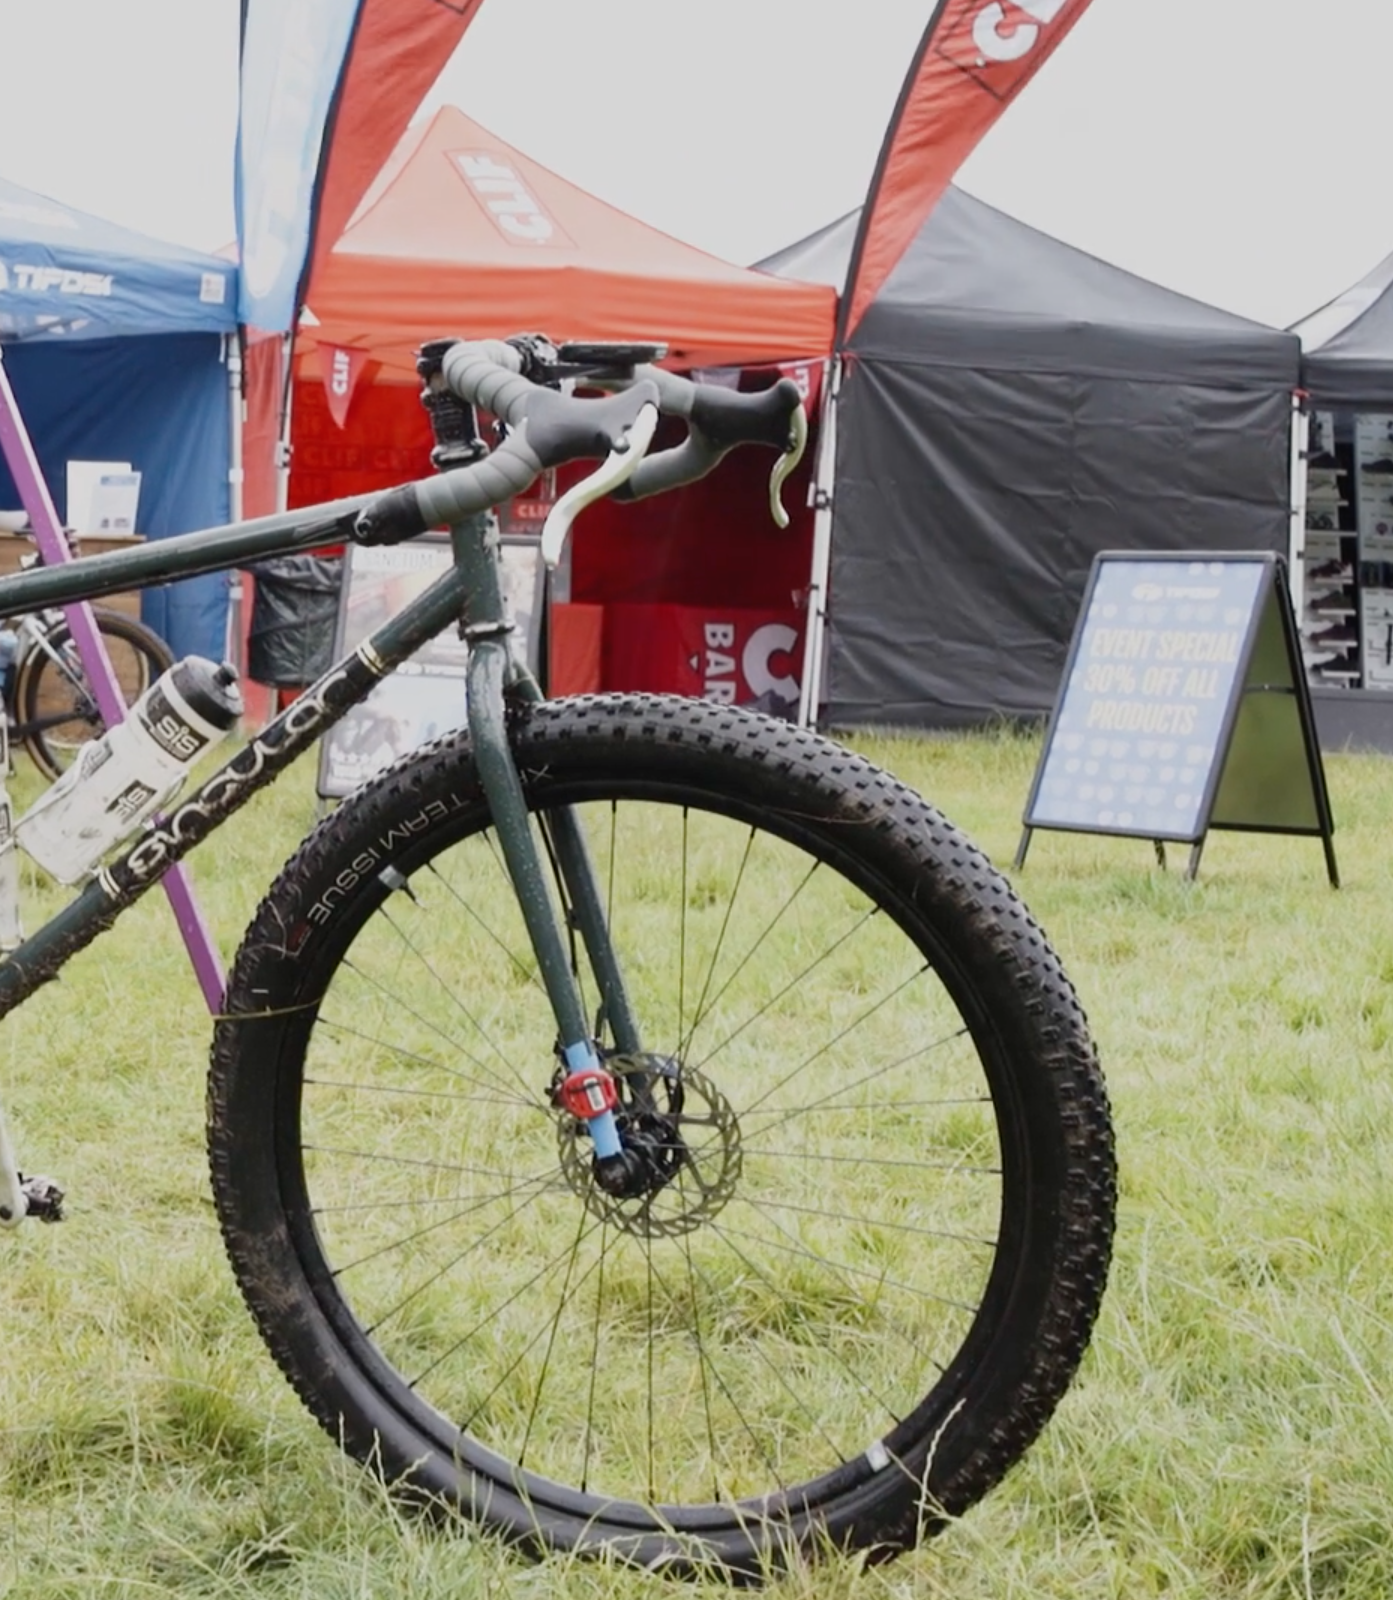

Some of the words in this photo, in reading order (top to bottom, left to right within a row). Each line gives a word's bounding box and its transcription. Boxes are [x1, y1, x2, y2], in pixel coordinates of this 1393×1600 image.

[457, 155, 553, 239] CLIF
[332, 349, 350, 396] CLIF
[704, 623, 737, 706] BAR
[1091, 629, 1154, 658] EVENT
[1157, 631, 1238, 663] SPECIAL
[1084, 663, 1136, 695] 30%
[1142, 667, 1182, 695] OFF
[1183, 669, 1219, 698] ALL
[1086, 700, 1199, 736] PRODUCTS
[379, 793, 470, 851] TEAM
[307, 846, 381, 926] ISSUE
